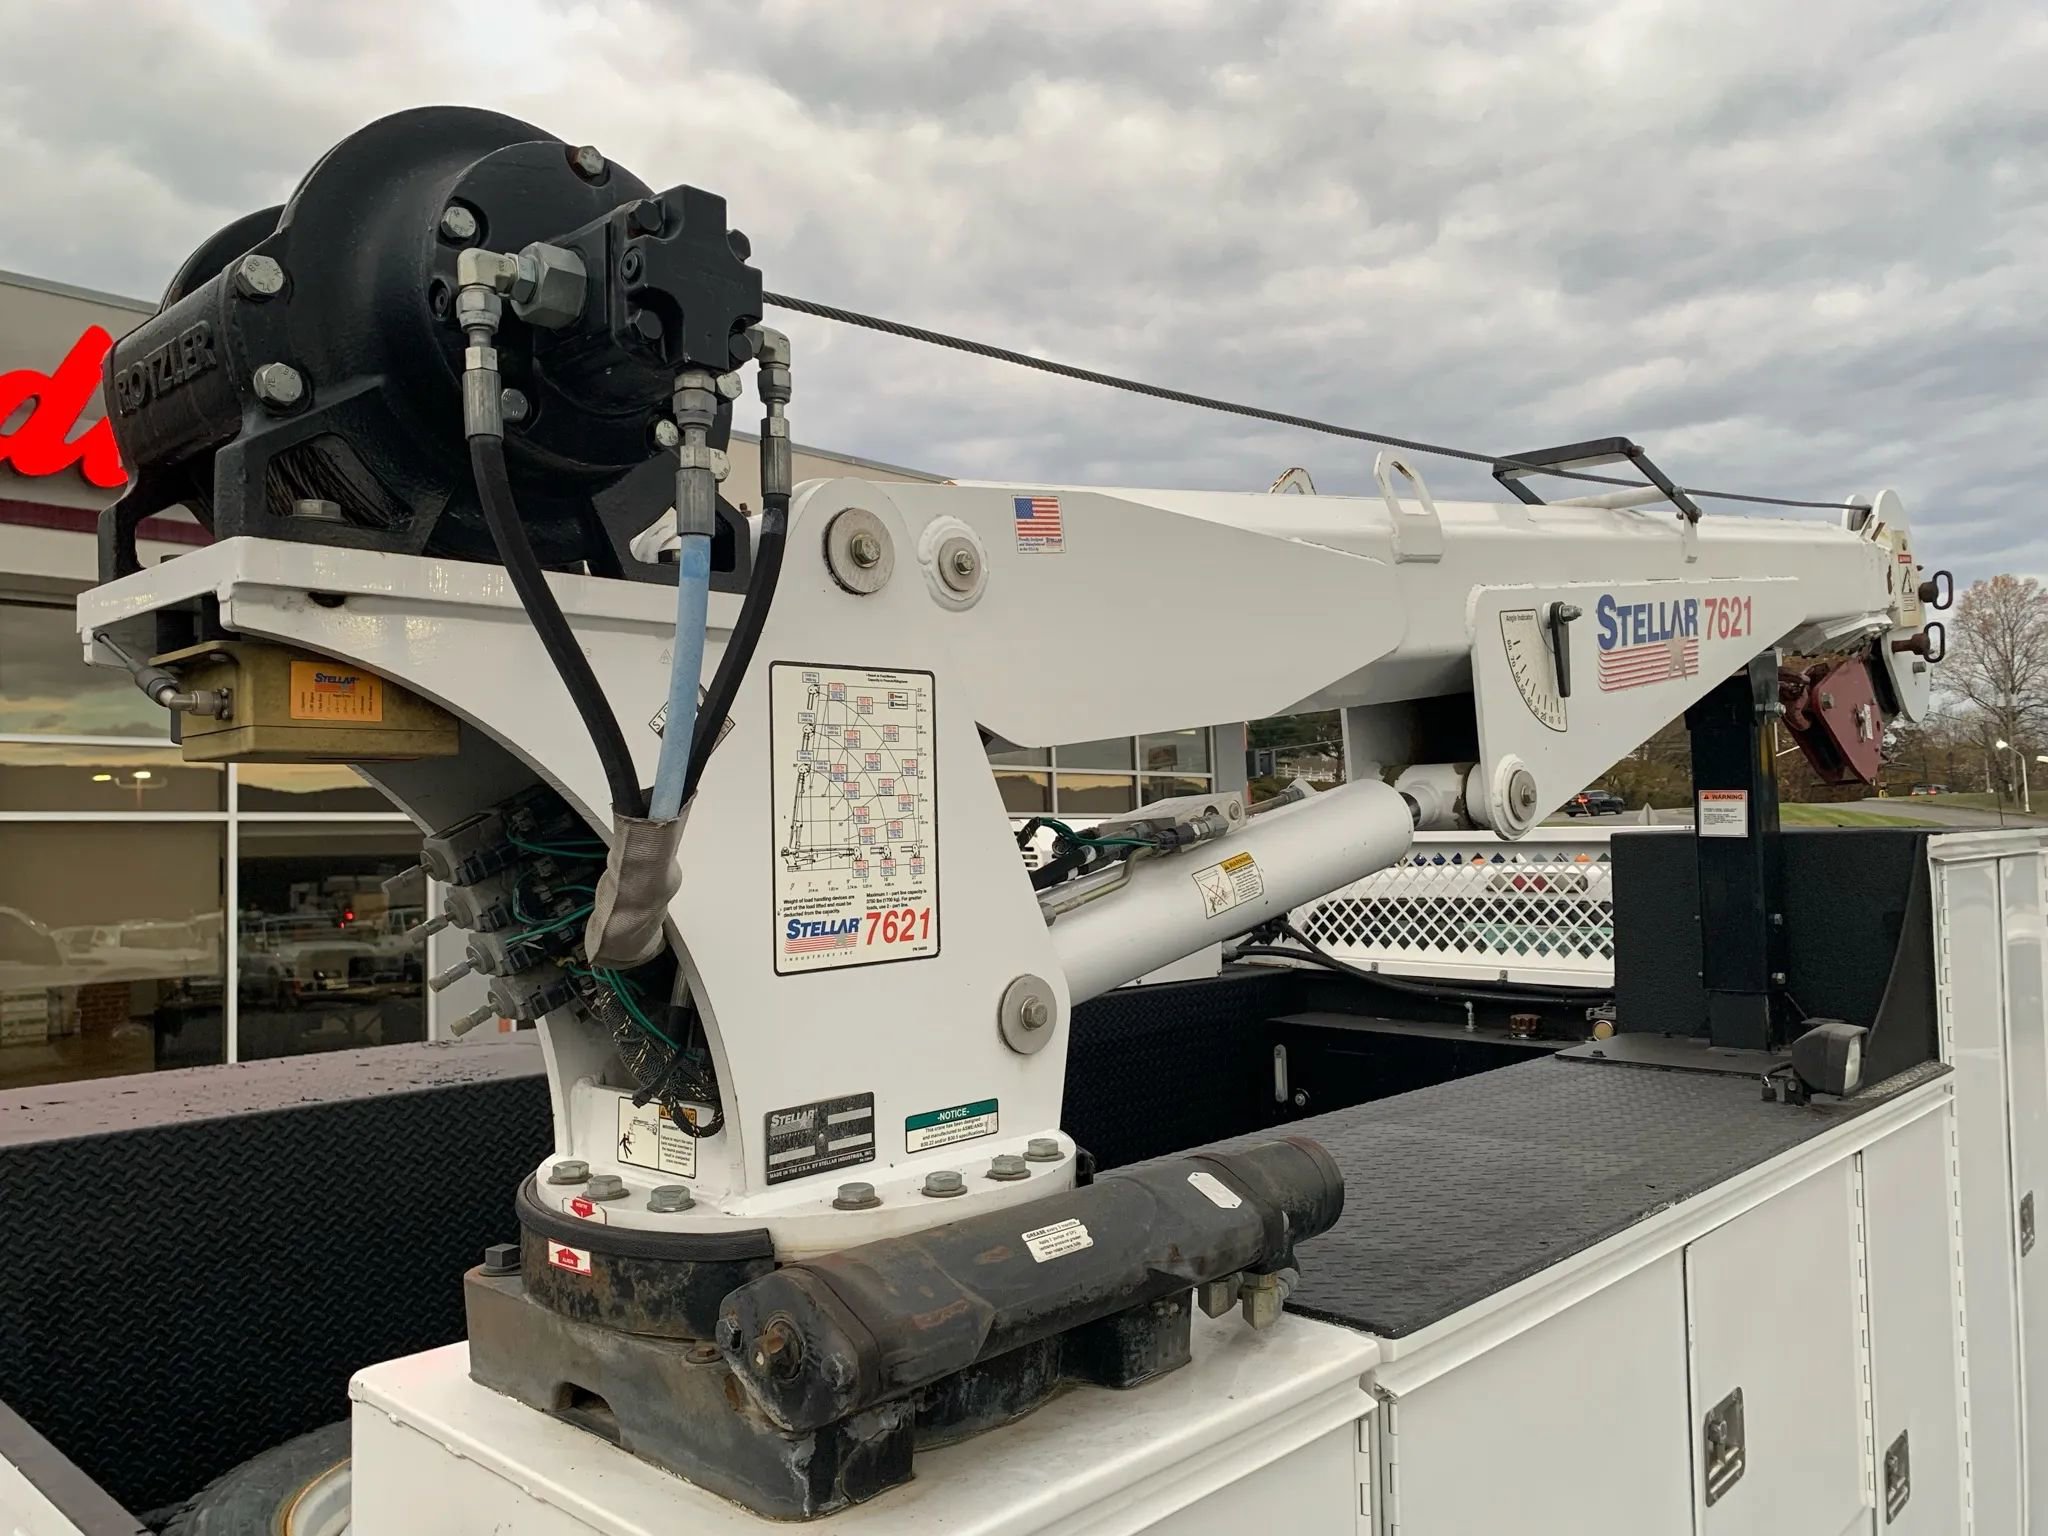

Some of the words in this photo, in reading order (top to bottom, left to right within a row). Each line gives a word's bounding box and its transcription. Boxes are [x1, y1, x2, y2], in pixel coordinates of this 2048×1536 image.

[114, 320, 216, 413] ROTZLER
[1597, 594, 1698, 650] STELLAR
[1704, 596, 1752, 640] 7621
[315, 672, 355, 684] STELLAR
[786, 918, 860, 940] STELLAR
[866, 907, 930, 945] 7621
[771, 1109, 815, 1127] STELLAR
[769, 1171, 782, 1179] MADE
[819, 1158, 837, 1167] STELLAR
[1026, 1229, 1046, 1239] GREASE
